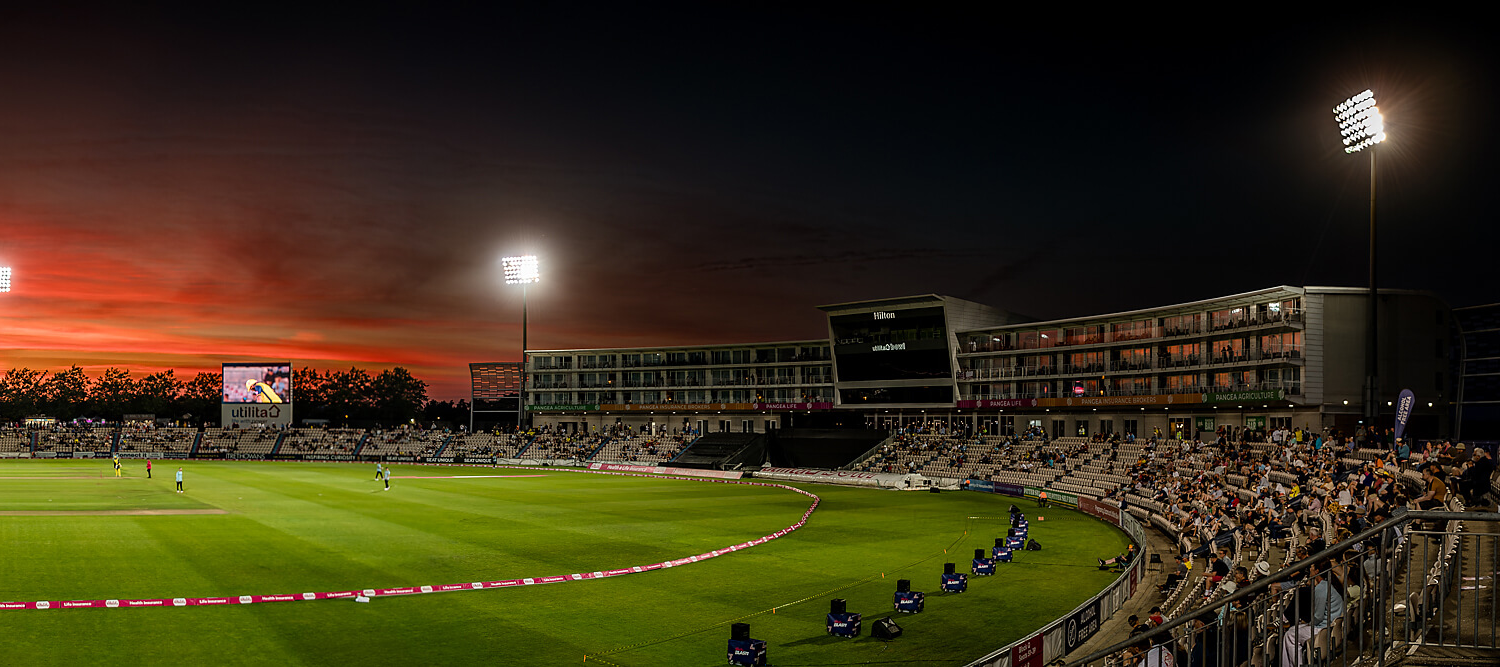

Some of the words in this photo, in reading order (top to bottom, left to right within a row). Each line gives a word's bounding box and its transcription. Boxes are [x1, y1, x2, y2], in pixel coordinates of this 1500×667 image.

[874, 312, 895, 320] Hilton
[1238, 392, 1274, 400] AGRICULTURE
[232, 407, 267, 418] utilita
[1398, 397, 1406, 421] ALCOHOL
[1205, 422, 1213, 430] BAR
[1080, 605, 1096, 624] ALCOHOL
[1078, 625, 1088, 642] FREE
[1089, 619, 1097, 634] AREA
